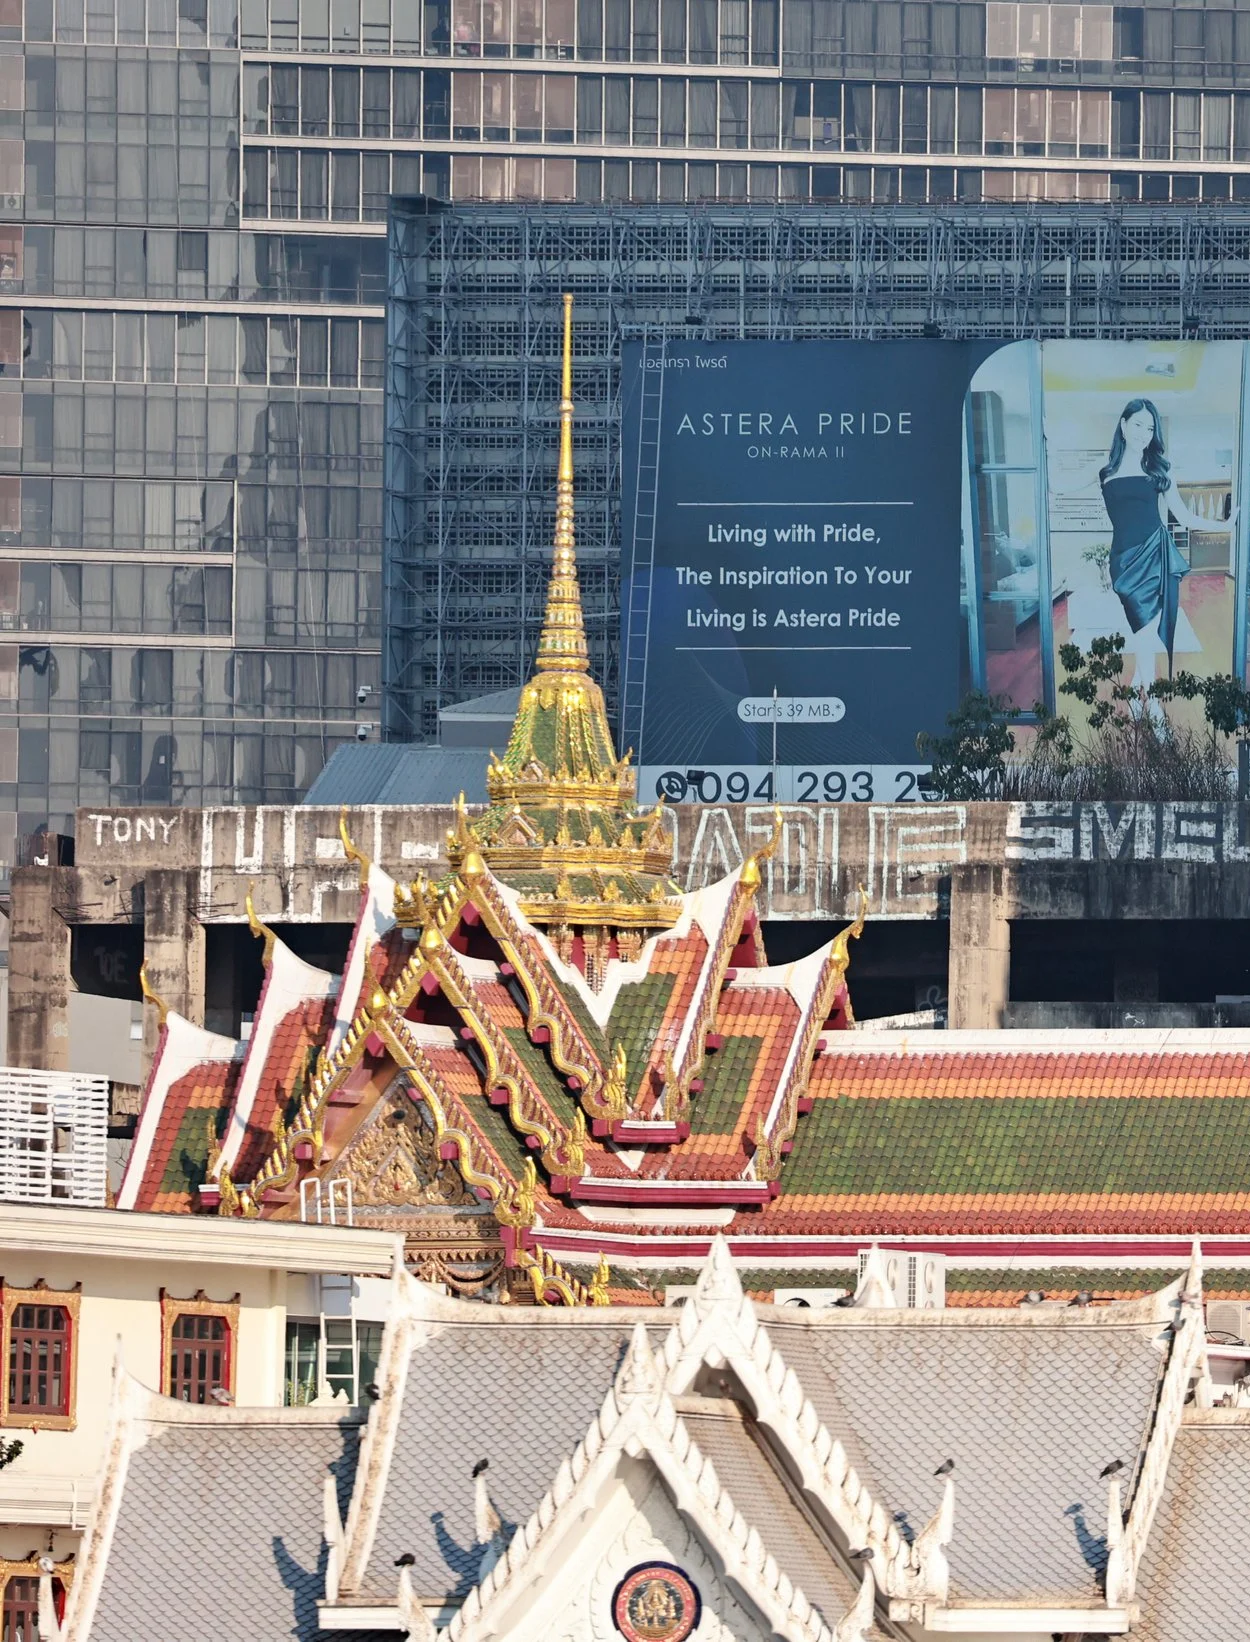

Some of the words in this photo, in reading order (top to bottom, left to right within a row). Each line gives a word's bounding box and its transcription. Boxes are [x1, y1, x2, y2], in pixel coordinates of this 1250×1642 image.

[695, 355, 728, 368] ไพรด์
[677, 413, 799, 435] ASTERA
[819, 412, 912, 435] PRIDE
[747, 446, 828, 458] ON-RAMA
[836, 446, 844, 458] II
[708, 524, 767, 547] Living
[774, 524, 816, 542] with
[823, 523, 881, 544] Pride,
[676, 566, 713, 585] The
[719, 566, 828, 589] Inspiration
[834, 566, 858, 585] To
[864, 566, 912, 585] Your
[687, 608, 746, 631] Living
[753, 608, 767, 627] is
[774, 608, 841, 627] Astera
[849, 607, 901, 627] Pride
[787, 704, 803, 717] 39
[697, 771, 778, 804] 094
[797, 771, 874, 803] 293
[88, 814, 178, 846] TONY
